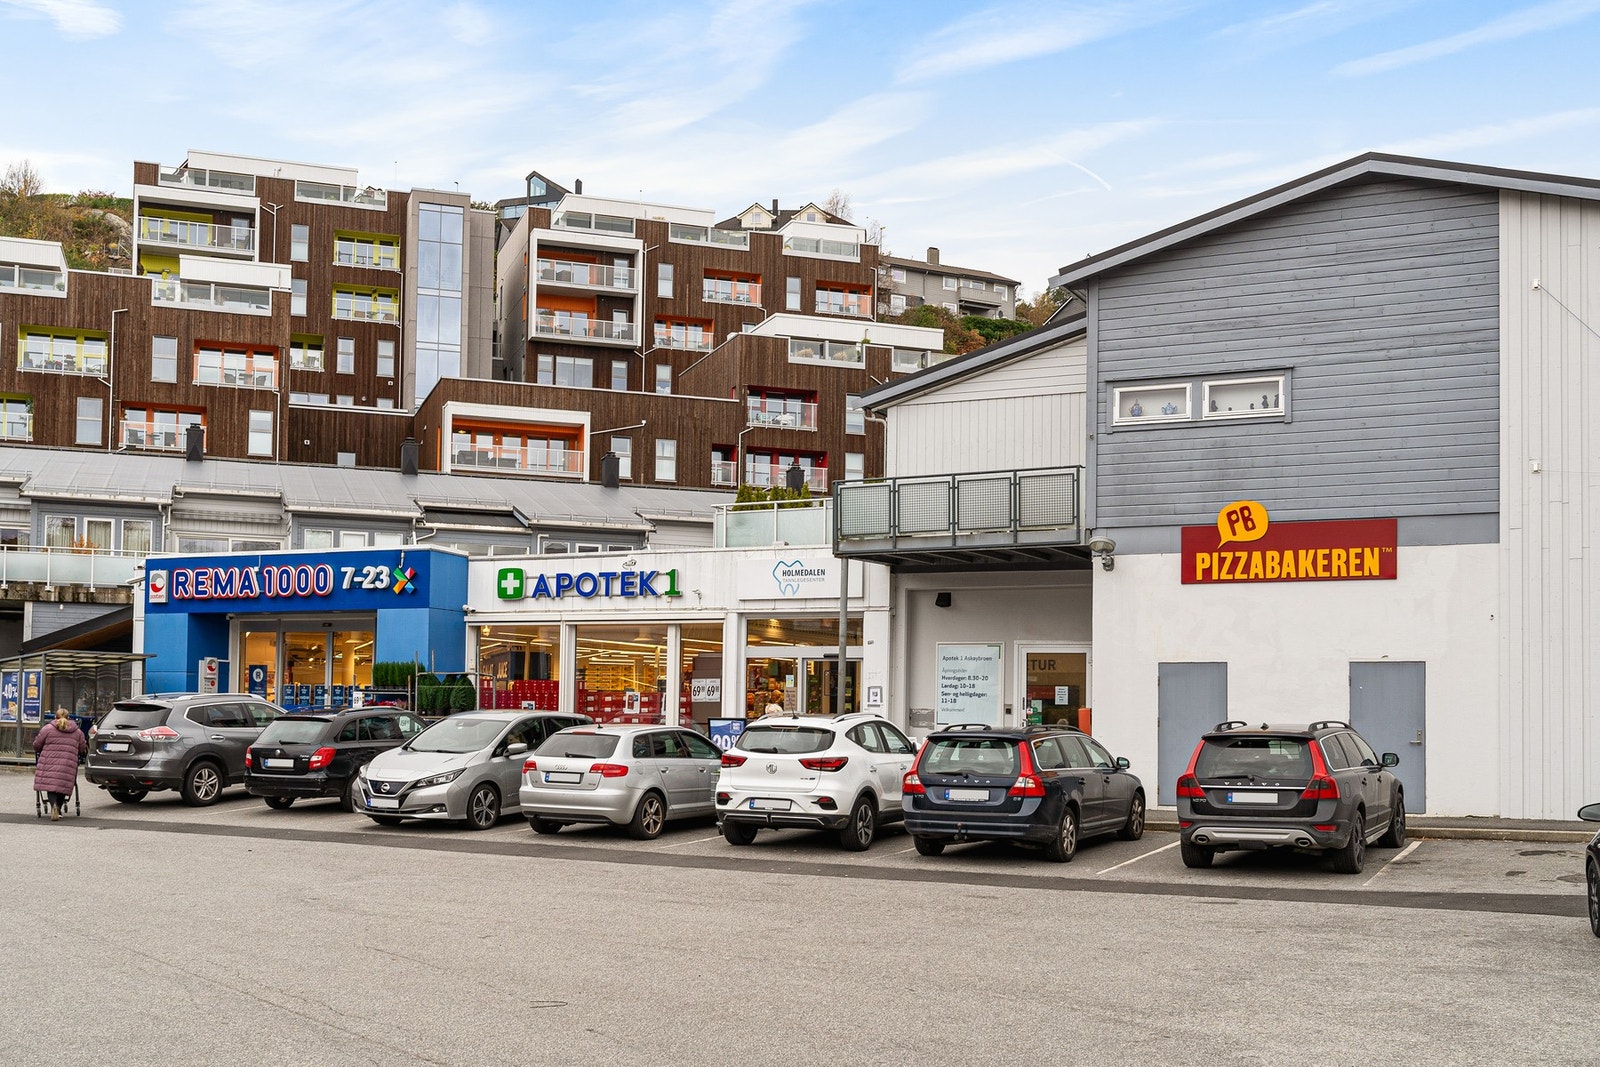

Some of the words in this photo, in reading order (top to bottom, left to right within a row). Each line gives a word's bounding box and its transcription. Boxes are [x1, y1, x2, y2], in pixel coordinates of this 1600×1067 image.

[1226, 505, 1257, 537] PB
[782, 568, 826, 577] HOLMEDALEN
[1196, 547, 1380, 581] PIZZABAKEREN
[172, 566, 259, 599] REMA
[264, 563, 334, 598] 1000
[340, 565, 391, 590] 7-23
[531, 570, 660, 599] APOTEK
[664, 568, 683, 597] 1
[1028, 659, 1056, 671] TUR
